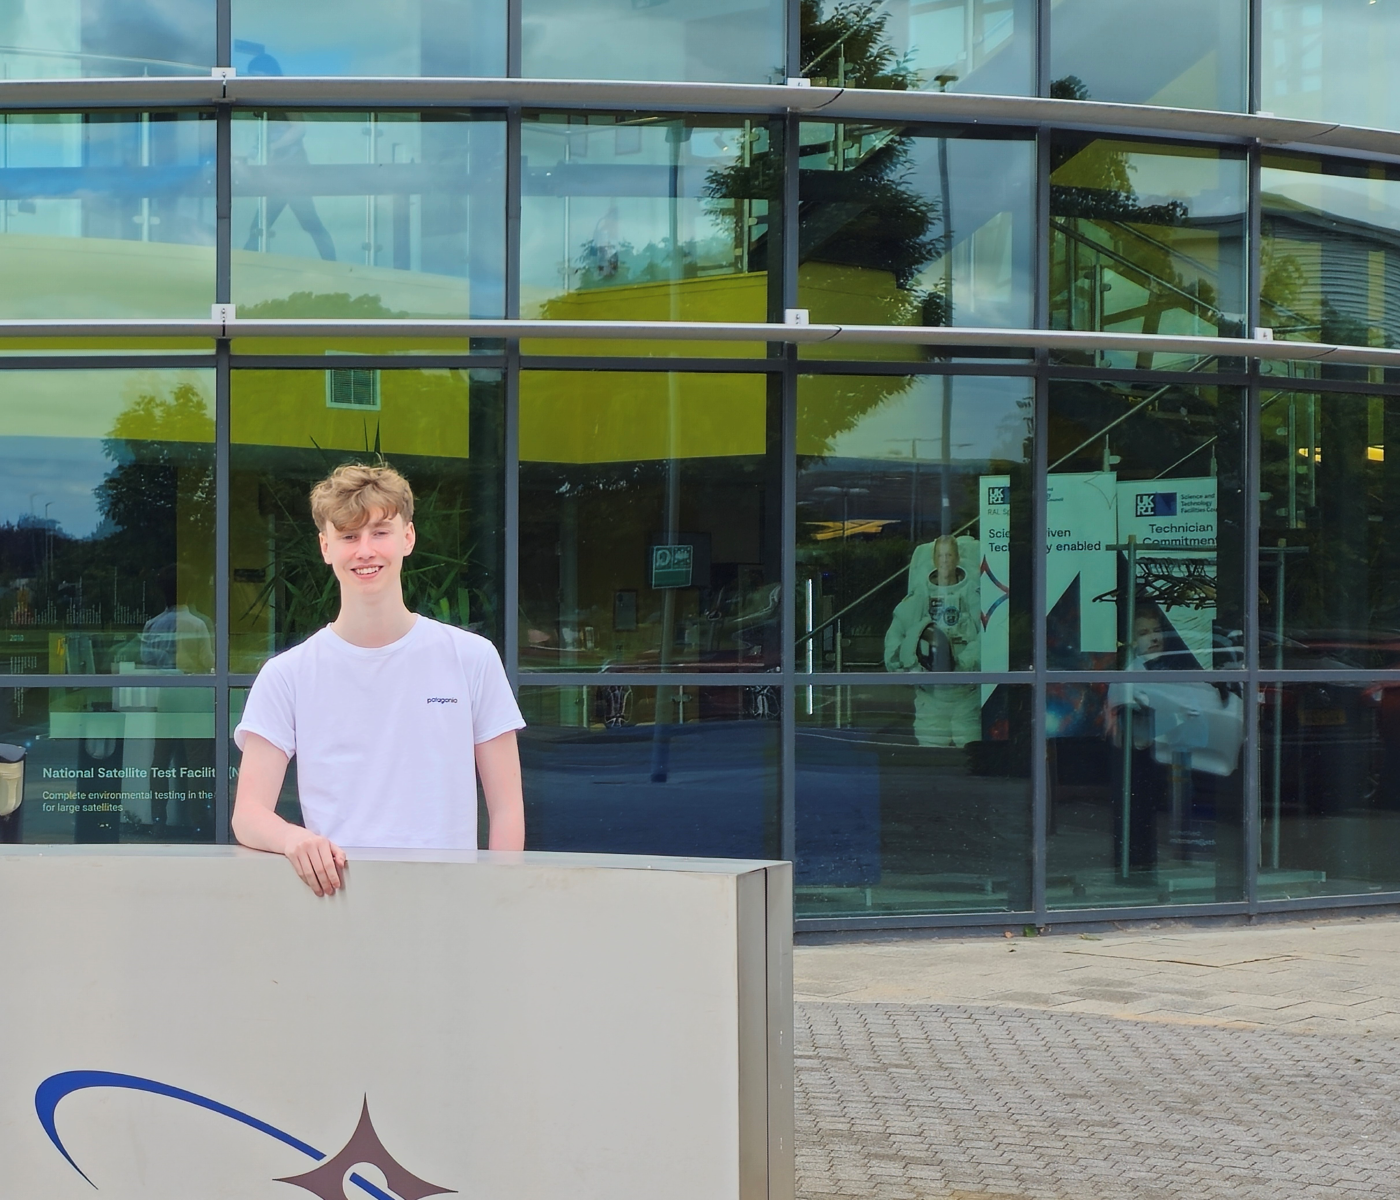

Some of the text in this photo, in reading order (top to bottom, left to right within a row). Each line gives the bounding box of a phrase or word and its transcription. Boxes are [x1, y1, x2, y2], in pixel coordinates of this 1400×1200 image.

[1181, 500, 1212, 508] Technology
[989, 529, 1010, 538] Scie
[1149, 523, 1213, 534] Technician
[1056, 541, 1101, 552] enabled
[42, 767, 94, 778] National
[97, 767, 147, 778] Satellite
[151, 767, 177, 778] Test
[180, 766, 216, 778] Facilit
[42, 790, 213, 802] Complete environmental testing in the
[42, 803, 124, 814] for large satellites
